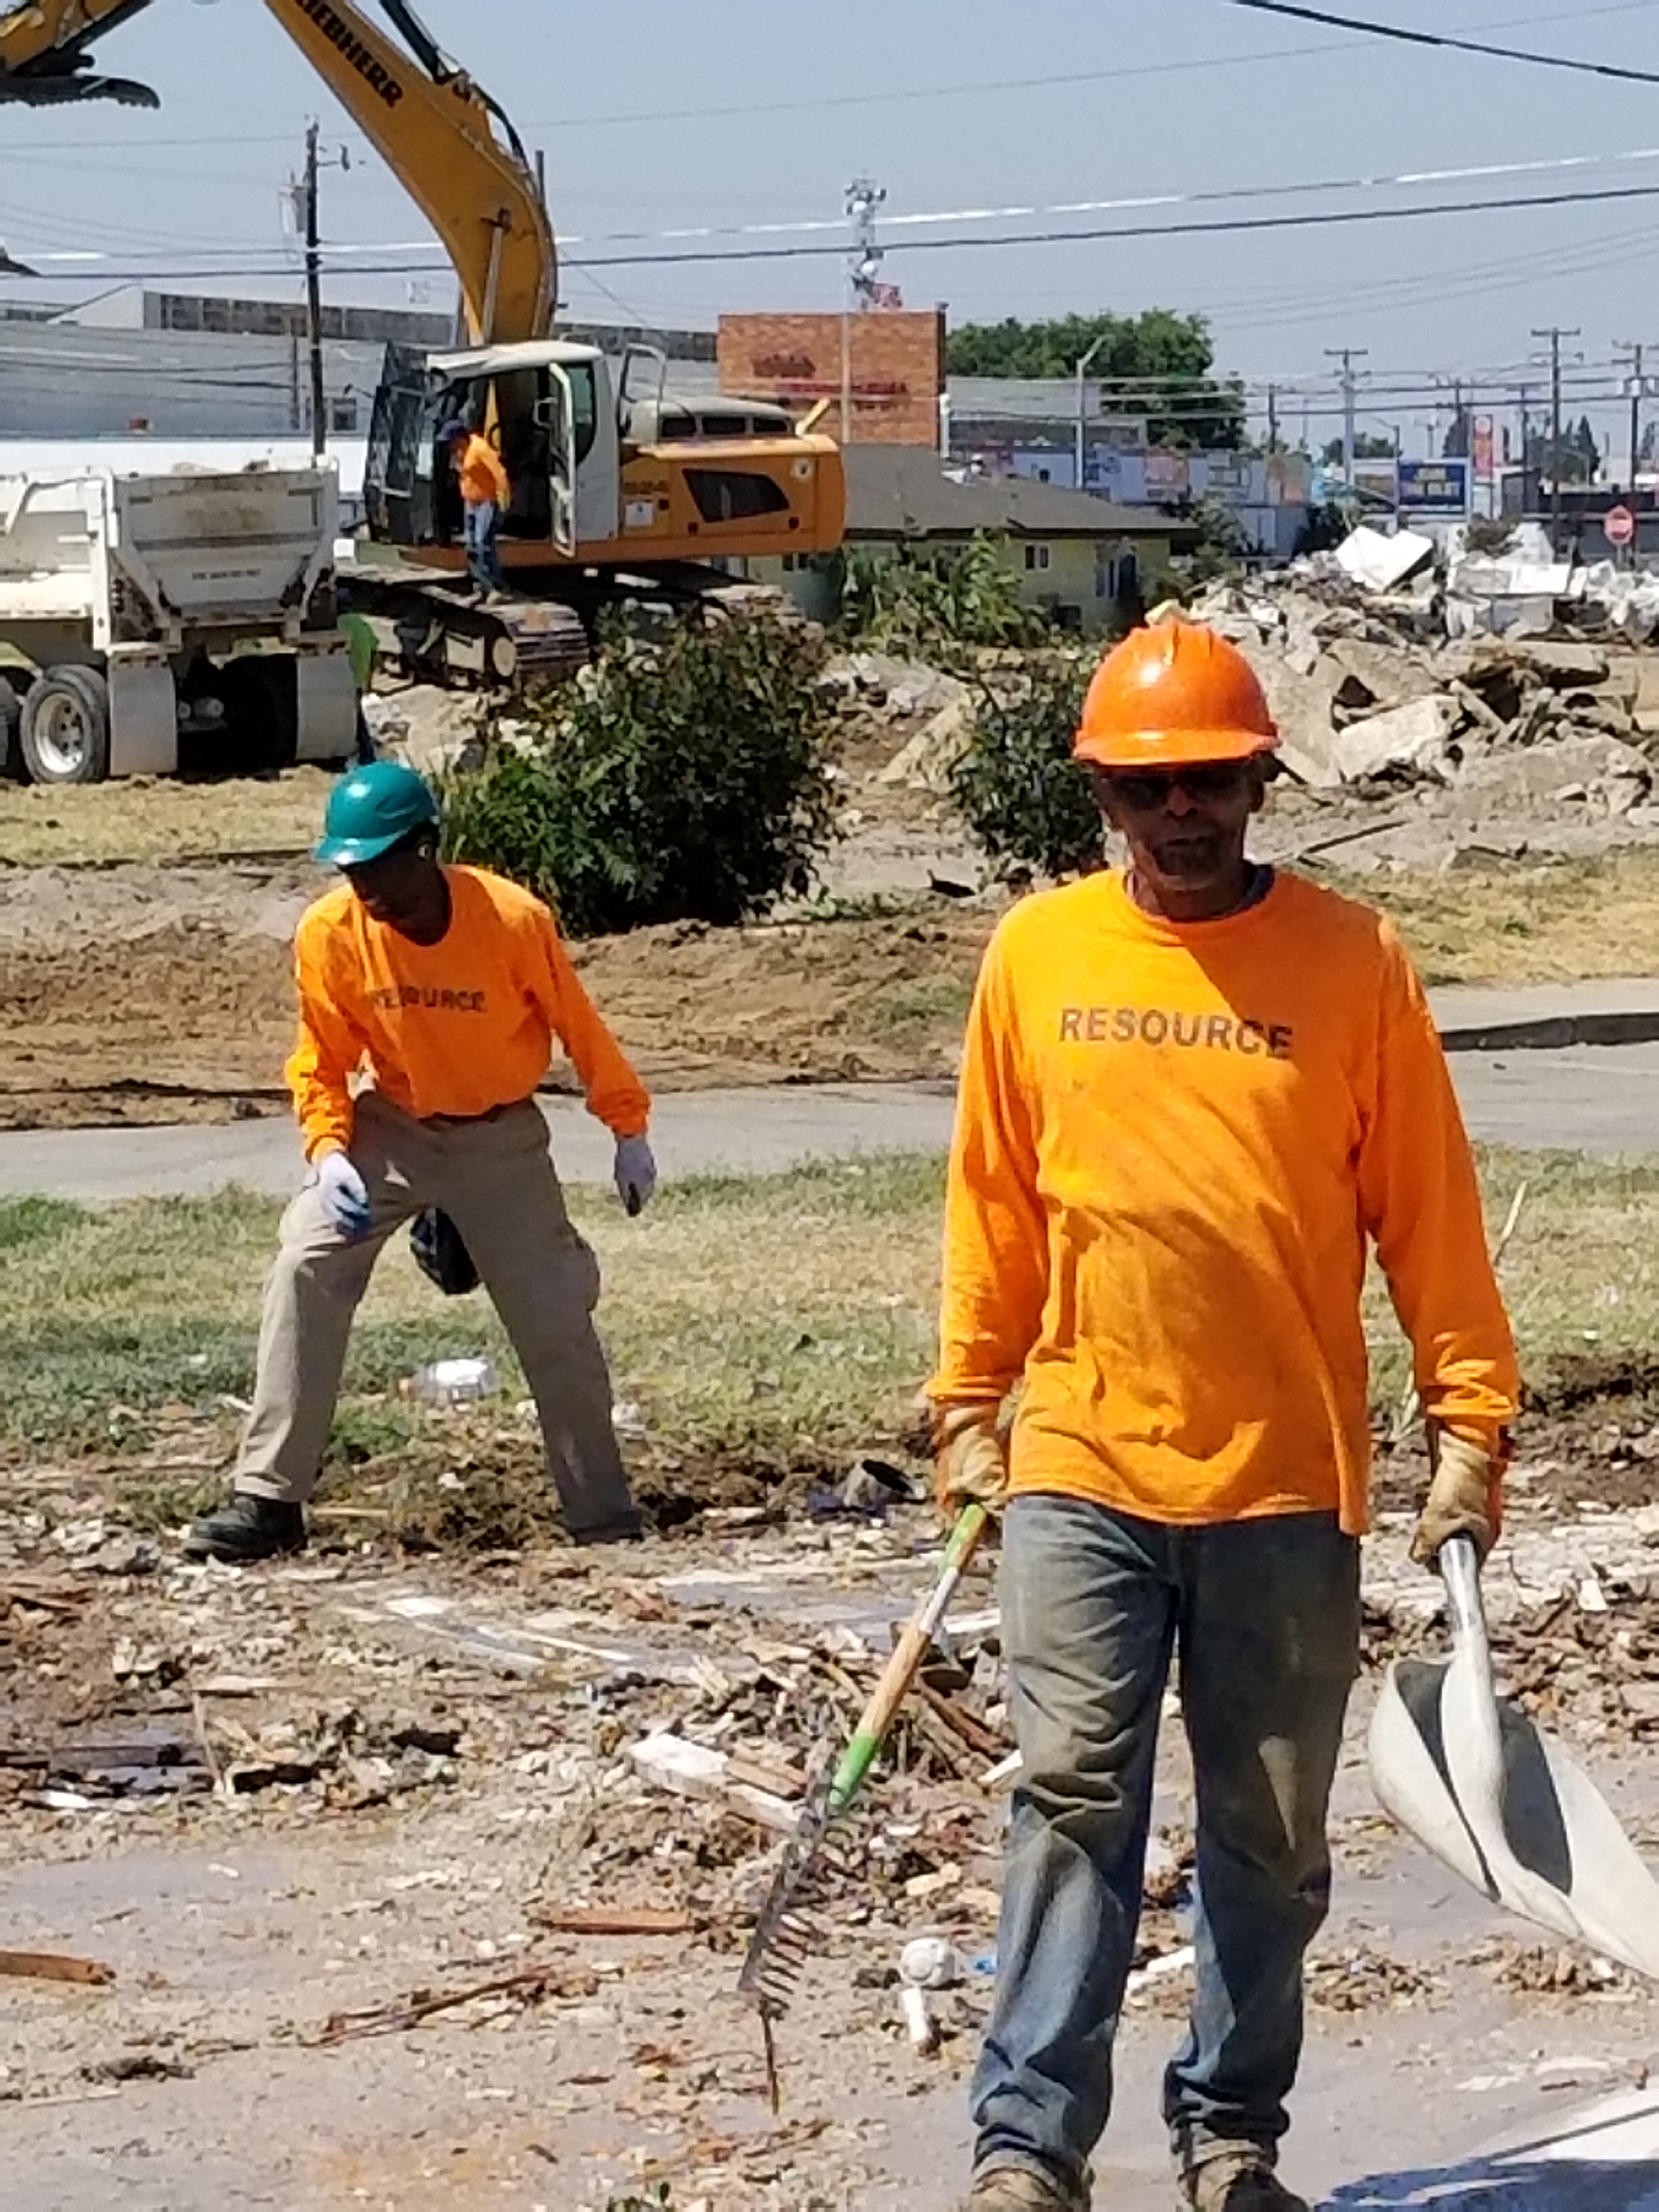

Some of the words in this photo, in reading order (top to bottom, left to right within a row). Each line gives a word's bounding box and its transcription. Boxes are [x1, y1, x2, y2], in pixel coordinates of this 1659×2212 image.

[295, 0, 403, 108] IEBHERR
[370, 986, 487, 1013] EOURCE
[1058, 1007, 1293, 1060] RESOURCE
